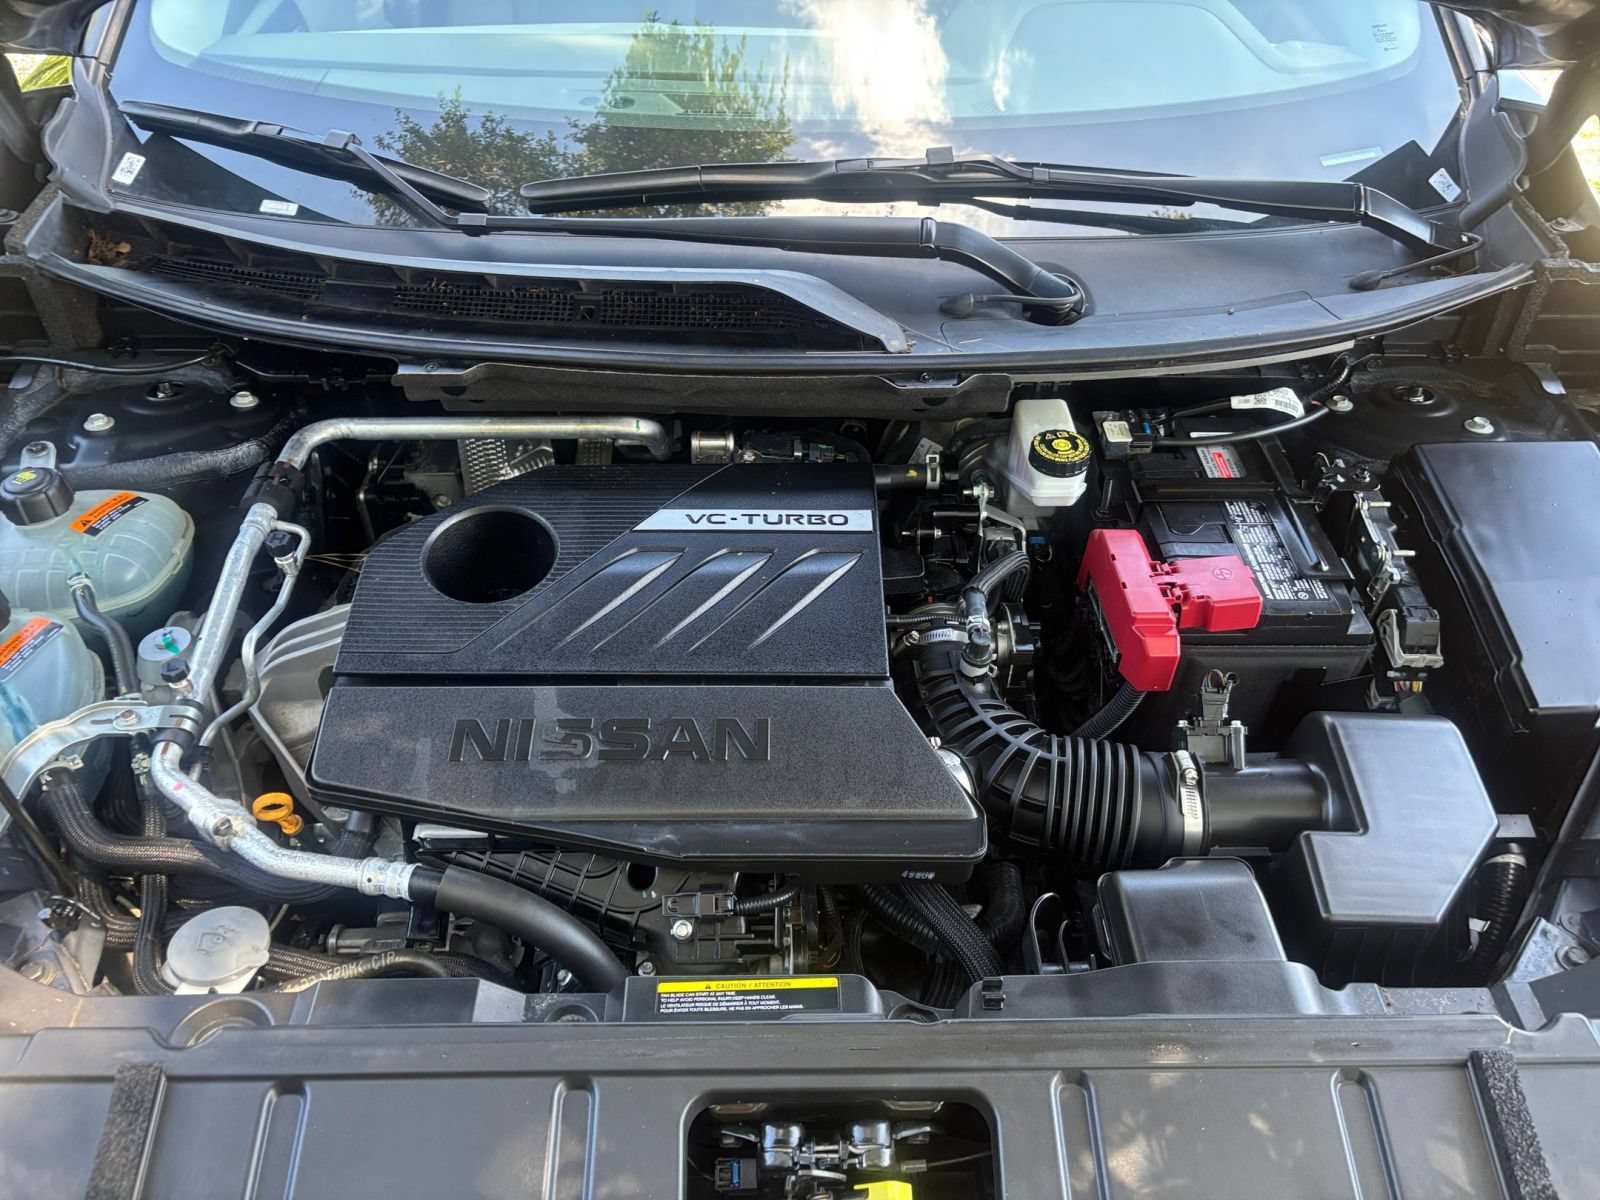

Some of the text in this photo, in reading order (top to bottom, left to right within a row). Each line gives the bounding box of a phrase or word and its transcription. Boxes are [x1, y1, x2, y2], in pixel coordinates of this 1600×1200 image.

[685, 513, 849, 526] VC-TURBO
[448, 718, 771, 761] NISSAN
[715, 982, 747, 990] CAUTION
